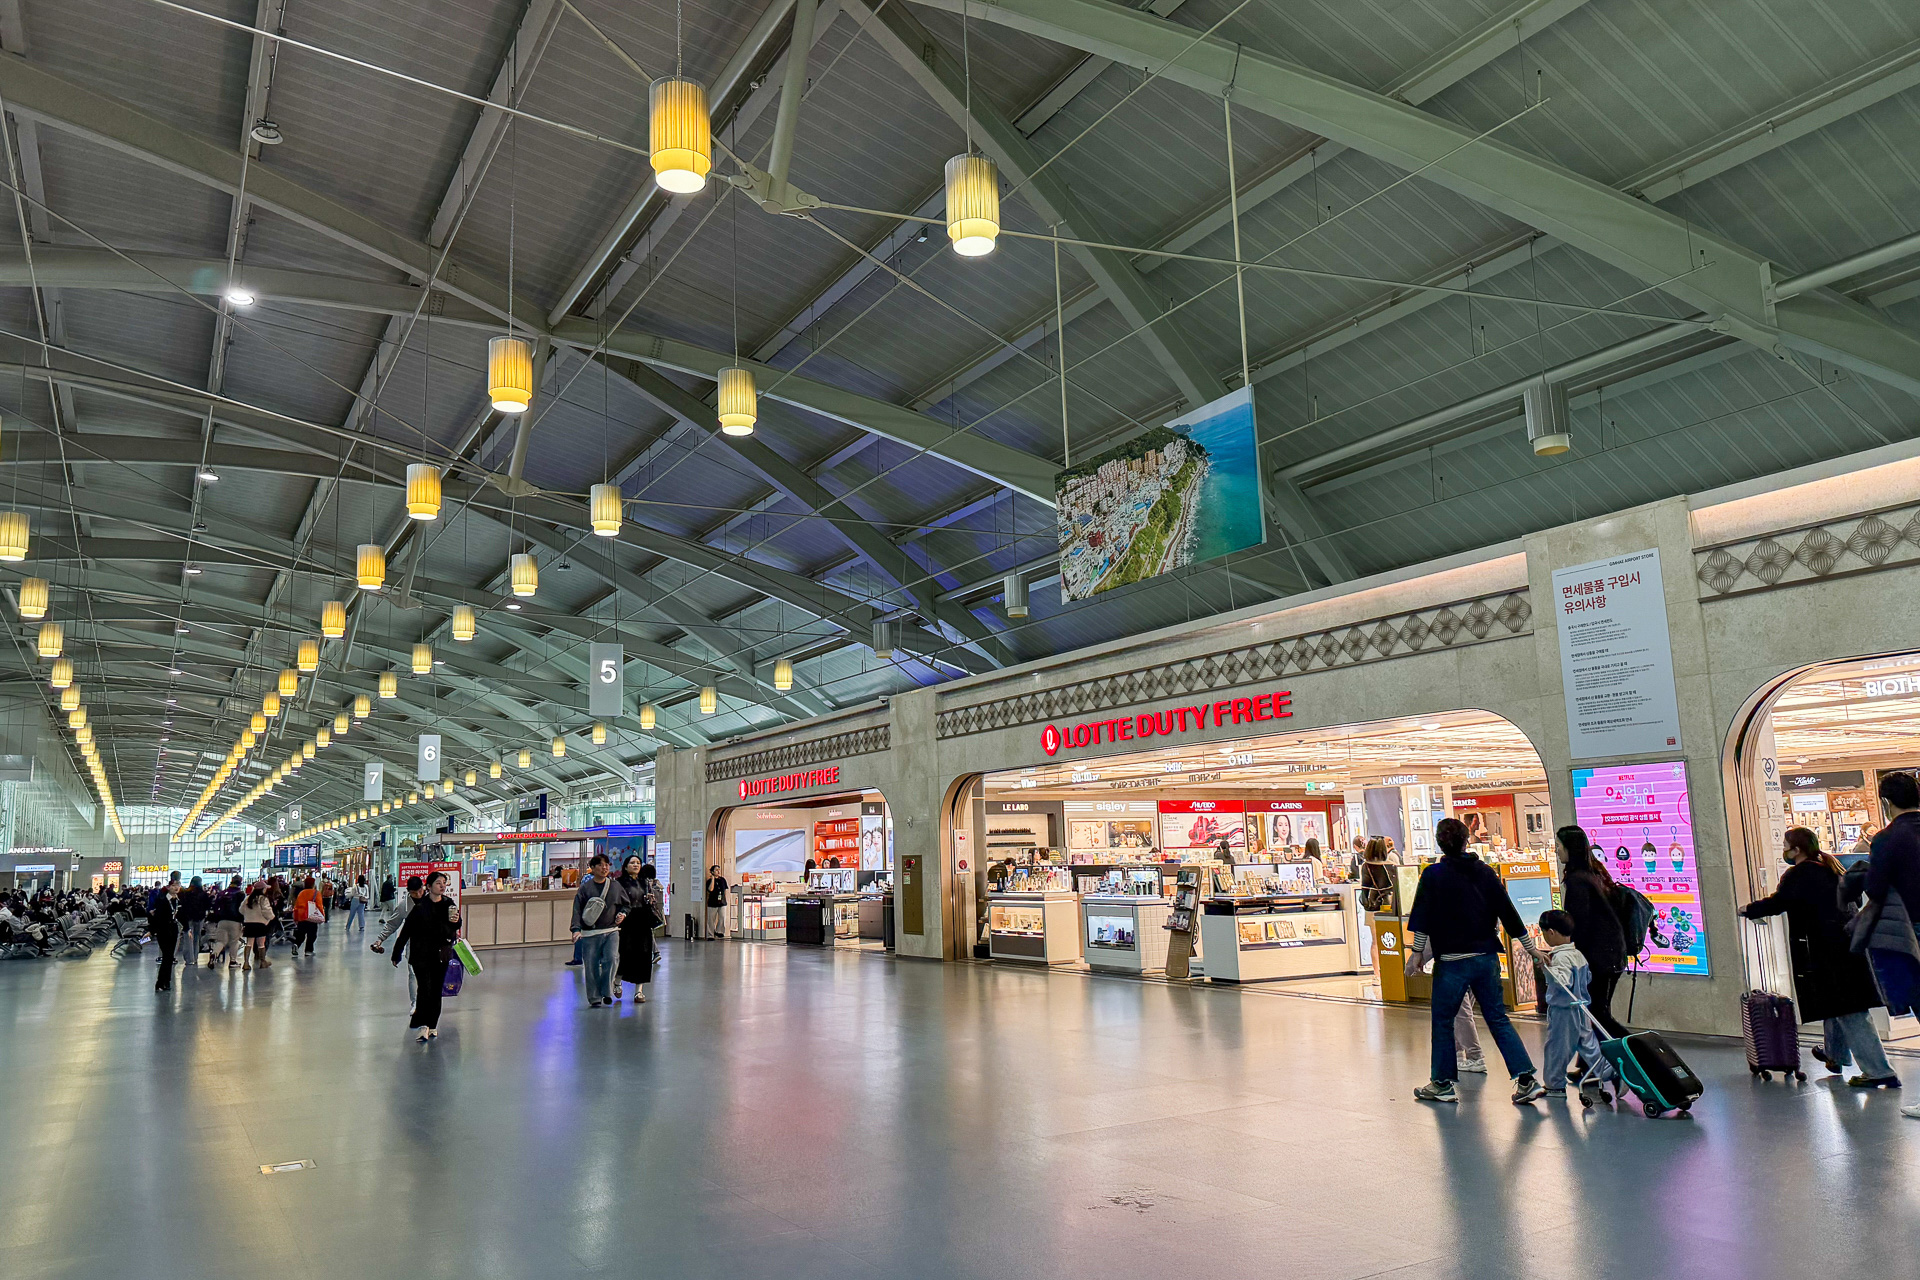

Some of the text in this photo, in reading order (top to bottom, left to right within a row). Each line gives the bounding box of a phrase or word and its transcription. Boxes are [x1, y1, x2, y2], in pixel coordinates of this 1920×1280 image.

[1562, 570, 1641, 598] 면세물품 구입시
[1564, 594, 1606, 614] 유의사항
[600, 660, 618, 684] 5
[1062, 716, 1133, 748] LOTTE
[1136, 704, 1209, 738] DUTY
[1213, 690, 1293, 727] FREE
[424, 746, 436, 761] 6
[369, 772, 379, 784] 7
[748, 766, 839, 796] LOTTE DUTY FREE
[1382, 774, 1418, 786] LANEIGE
[1002, 803, 1029, 812] LE LABO
[1096, 802, 1126, 812] sisley
[1452, 798, 1477, 807] ERMÈS
[291, 810, 300, 820] 8
[279, 818, 286, 826] 8
[257, 828, 264, 836] 9
[1510, 864, 1541, 874] L'OCCITANE
